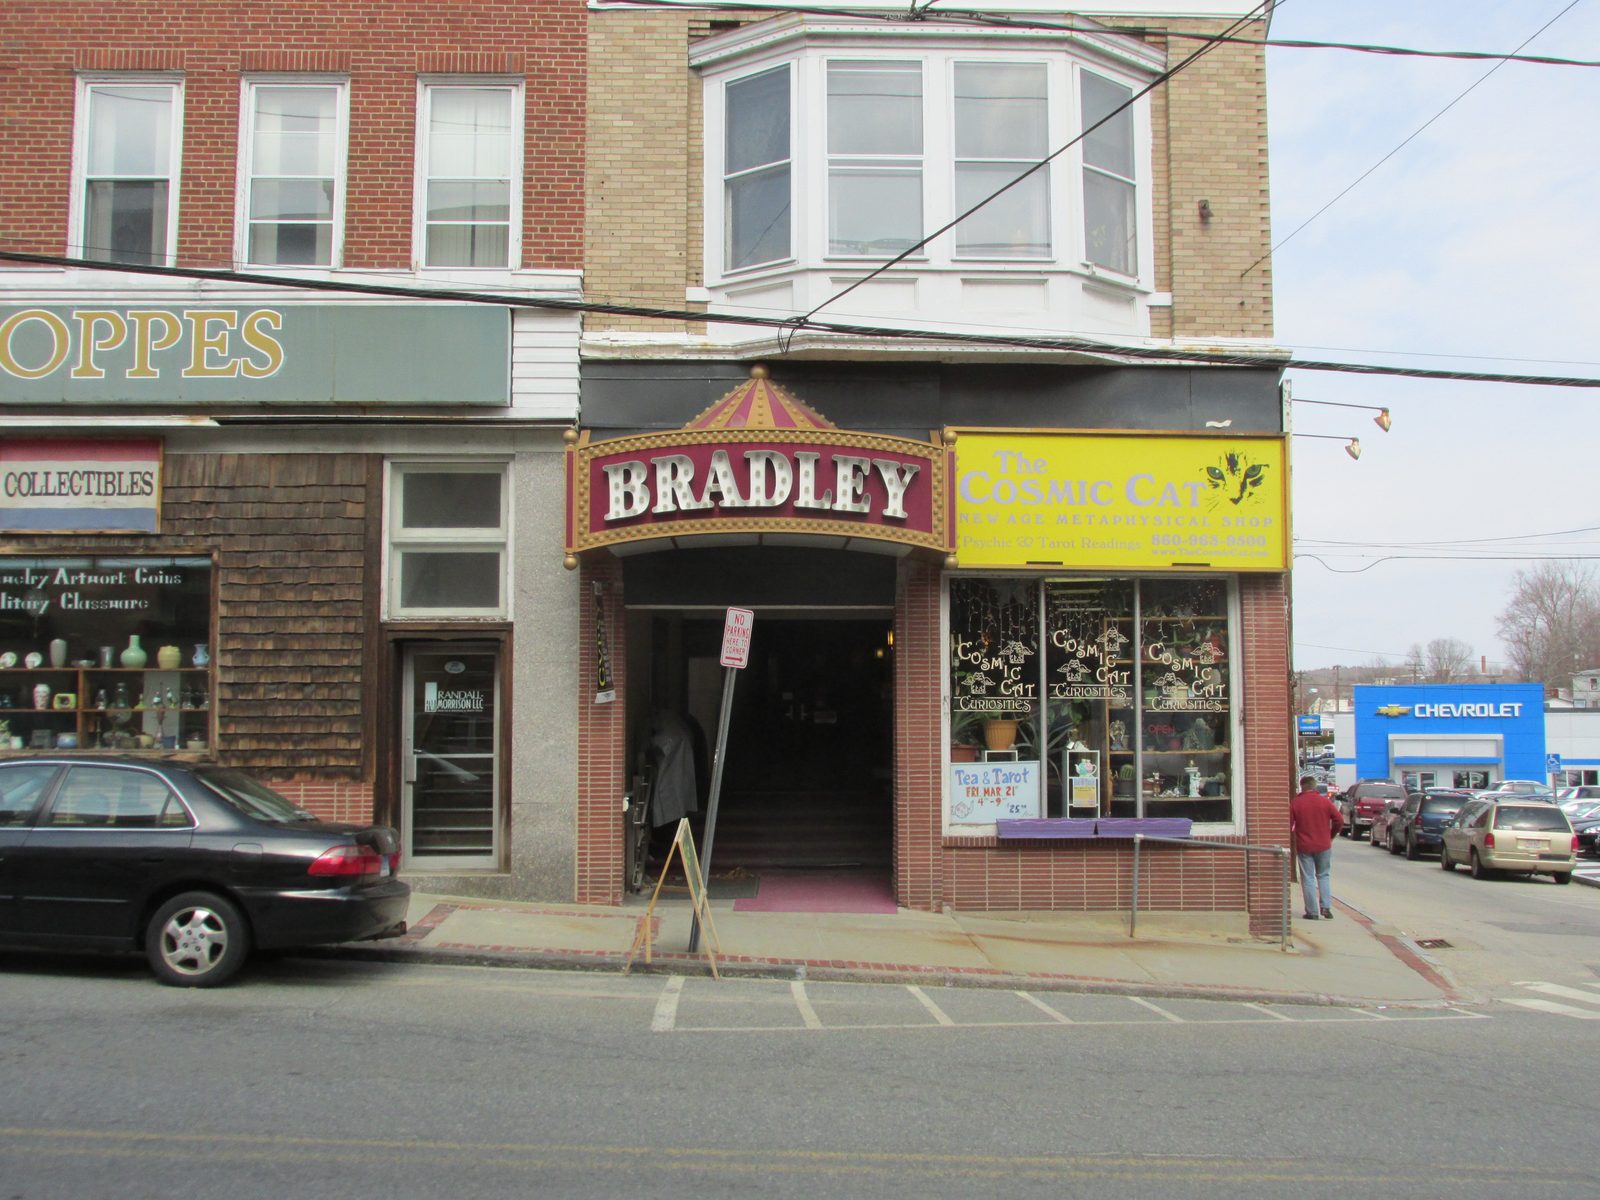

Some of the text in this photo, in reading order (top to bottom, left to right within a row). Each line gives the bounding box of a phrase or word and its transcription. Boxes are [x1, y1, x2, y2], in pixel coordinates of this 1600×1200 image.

[0, 309, 284, 379] OPPES
[992, 451, 1048, 474] The
[4, 470, 154, 497] COLLECTIBLES
[602, 449, 921, 521] BRADLEY
[959, 470, 1208, 508] COSMIC CAT
[959, 512, 1273, 528] NEW AGE METAPHYSICAL SHOP
[962, 535, 1142, 551] Psychic & Tarot Readings
[0, 567, 182, 589] welry Artwork Coins
[735, 614, 744, 625] NO
[726, 625, 749, 639] PARKING
[726, 638, 748, 648] HERE TO
[726, 647, 745, 655] CORNER
[1053, 628, 1117, 668] COSMIC
[958, 641, 1022, 680] COSMIC
[1148, 642, 1212, 681] COSMIC
[1096, 666, 1131, 685] CAT
[1001, 678, 1035, 697] CAT
[1055, 682, 1127, 700] CURIOSITIES
[1192, 680, 1226, 698] CAT
[437, 699, 472, 709] MORRISON
[472, 699, 483, 709] LLC
[959, 695, 1032, 713] CURIOSITIES
[1151, 696, 1222, 713] CURIOSITIES
[1414, 703, 1523, 718] CHEVROLET
[955, 767, 1030, 786] Tea & Tarot
[966, 786, 979, 798] FRI
[983, 786, 1002, 797] MAR
